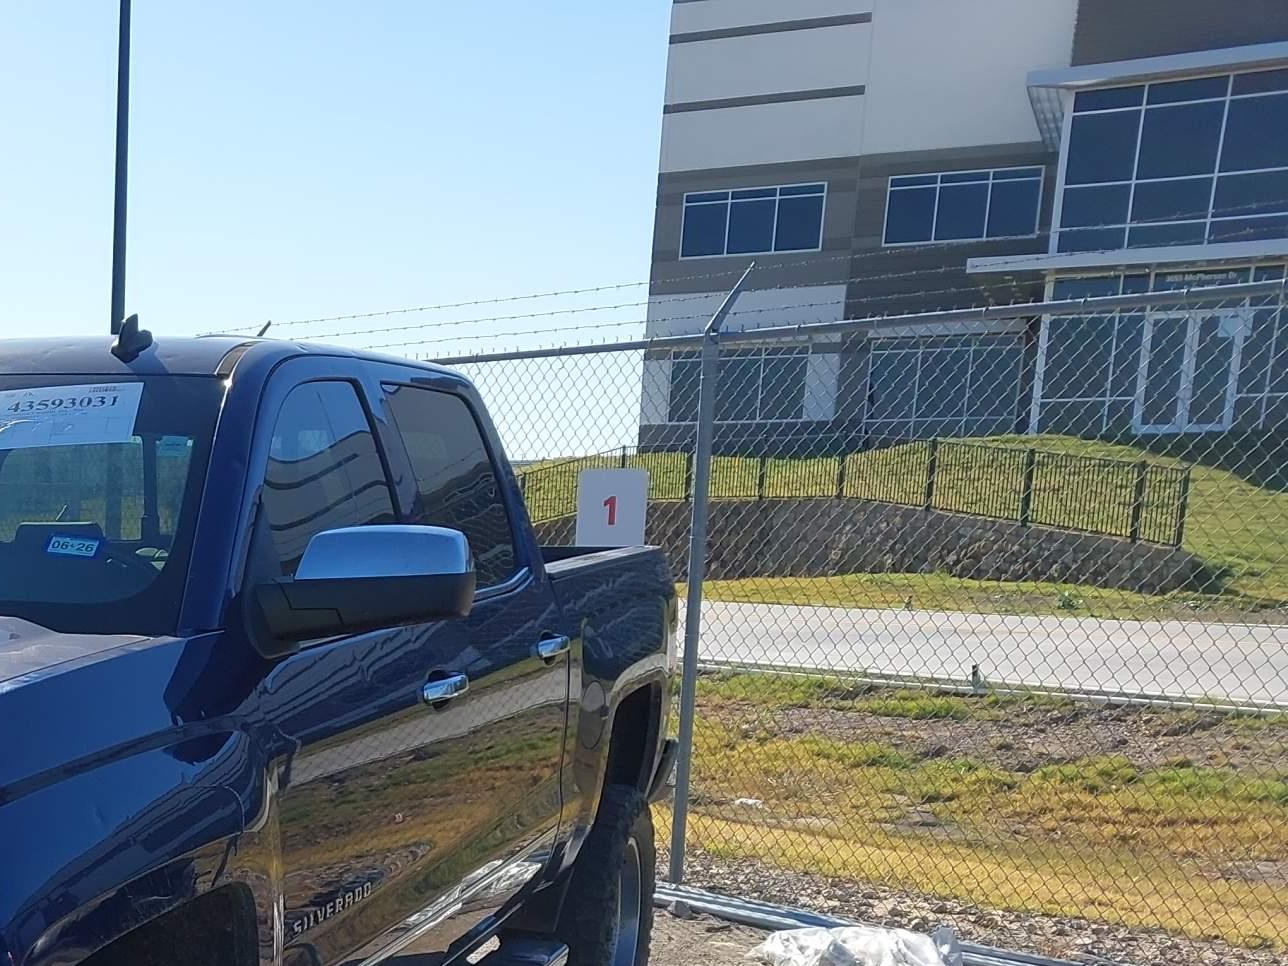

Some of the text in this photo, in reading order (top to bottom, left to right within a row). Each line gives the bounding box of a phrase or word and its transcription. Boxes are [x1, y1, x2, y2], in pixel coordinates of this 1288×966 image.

[8, 395, 119, 413] 43593031
[604, 495, 617, 526] 1
[293, 882, 372, 934] SILVERADO
